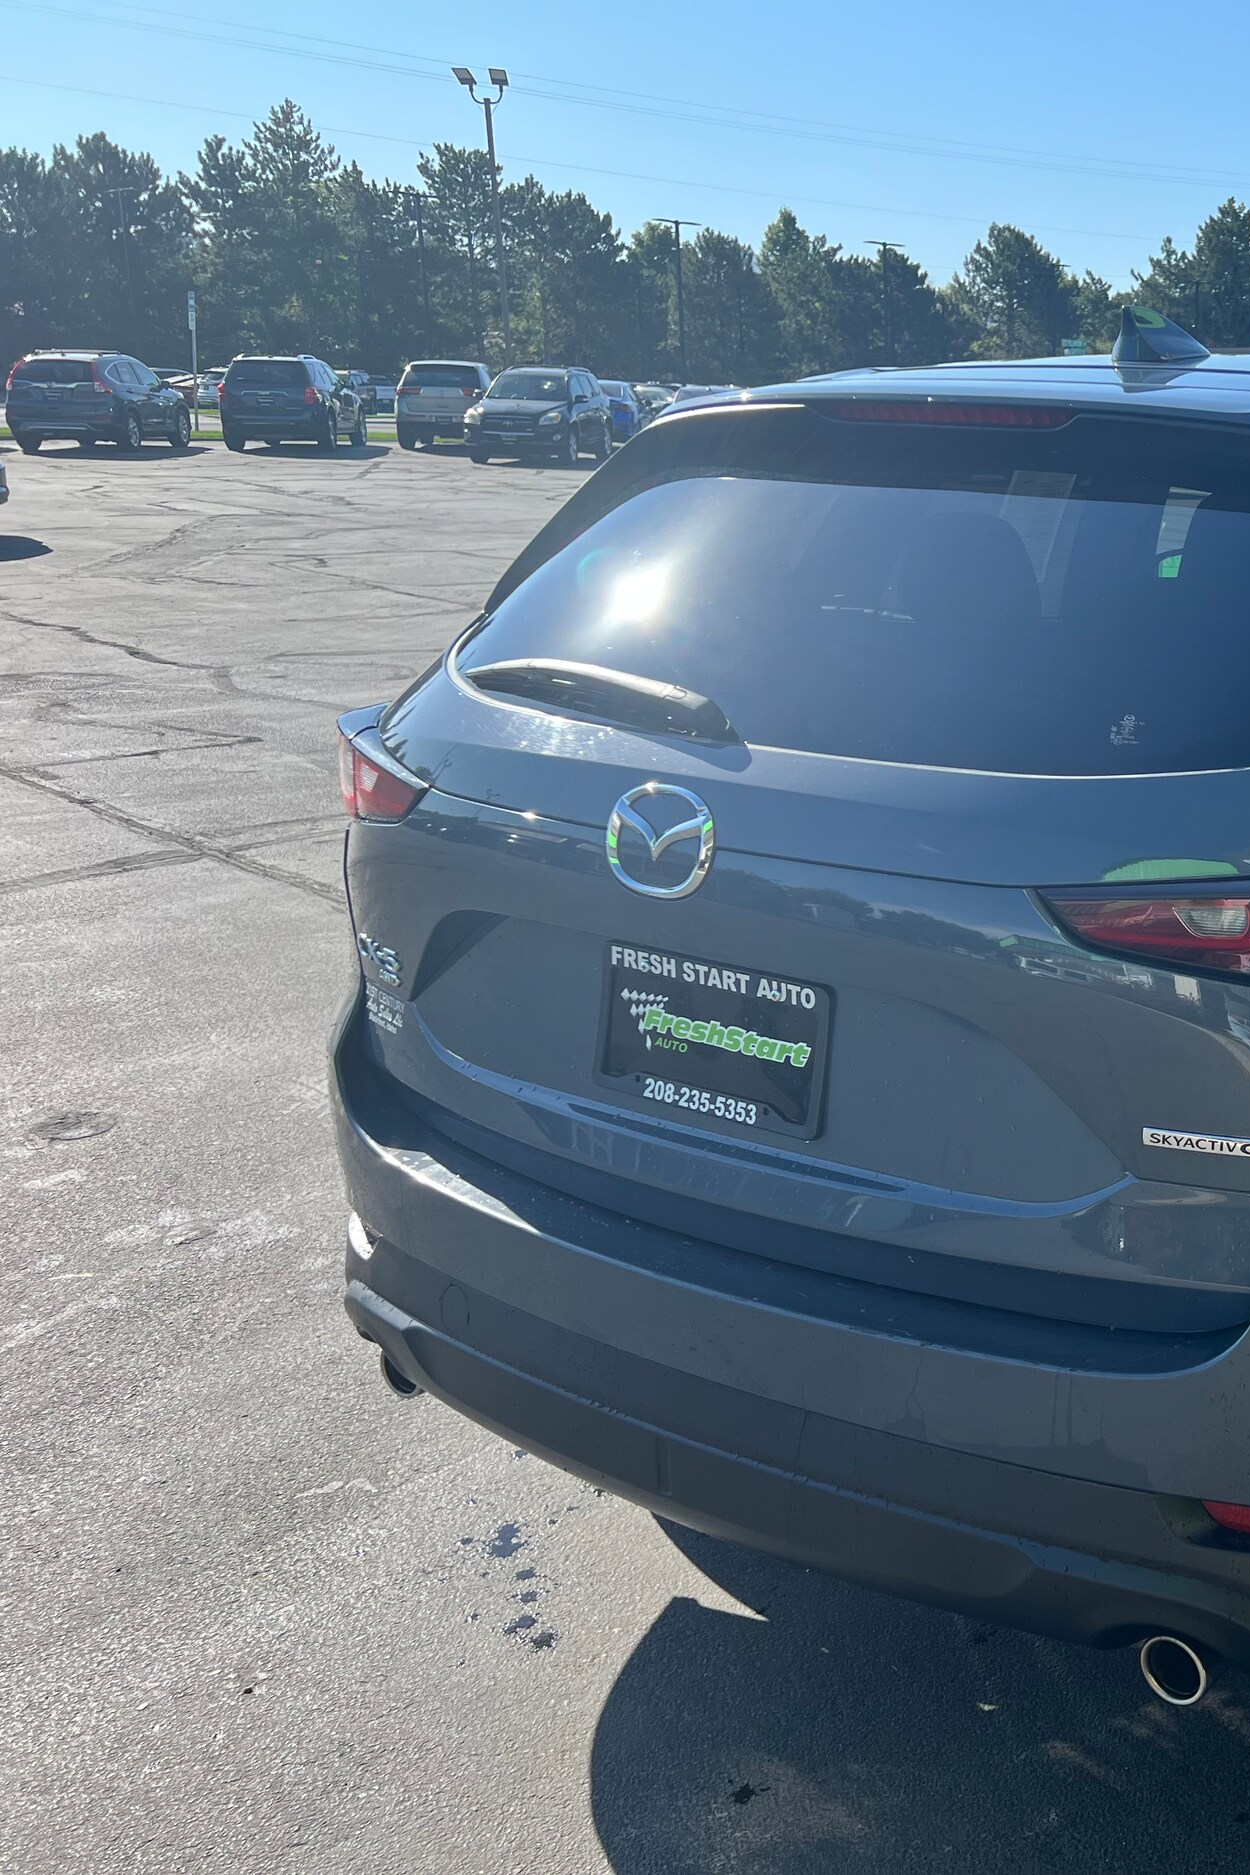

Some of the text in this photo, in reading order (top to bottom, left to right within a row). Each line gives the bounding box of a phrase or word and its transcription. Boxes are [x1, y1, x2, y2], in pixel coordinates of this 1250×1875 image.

[379, 968, 401, 987] AWD
[610, 945, 817, 1010] FRESH START AUTO
[379, 990, 405, 1014] CENTURY
[642, 1007, 812, 1068] FreshStart
[654, 1037, 689, 1053] AUTO
[642, 1077, 758, 1126] 208-235-5353
